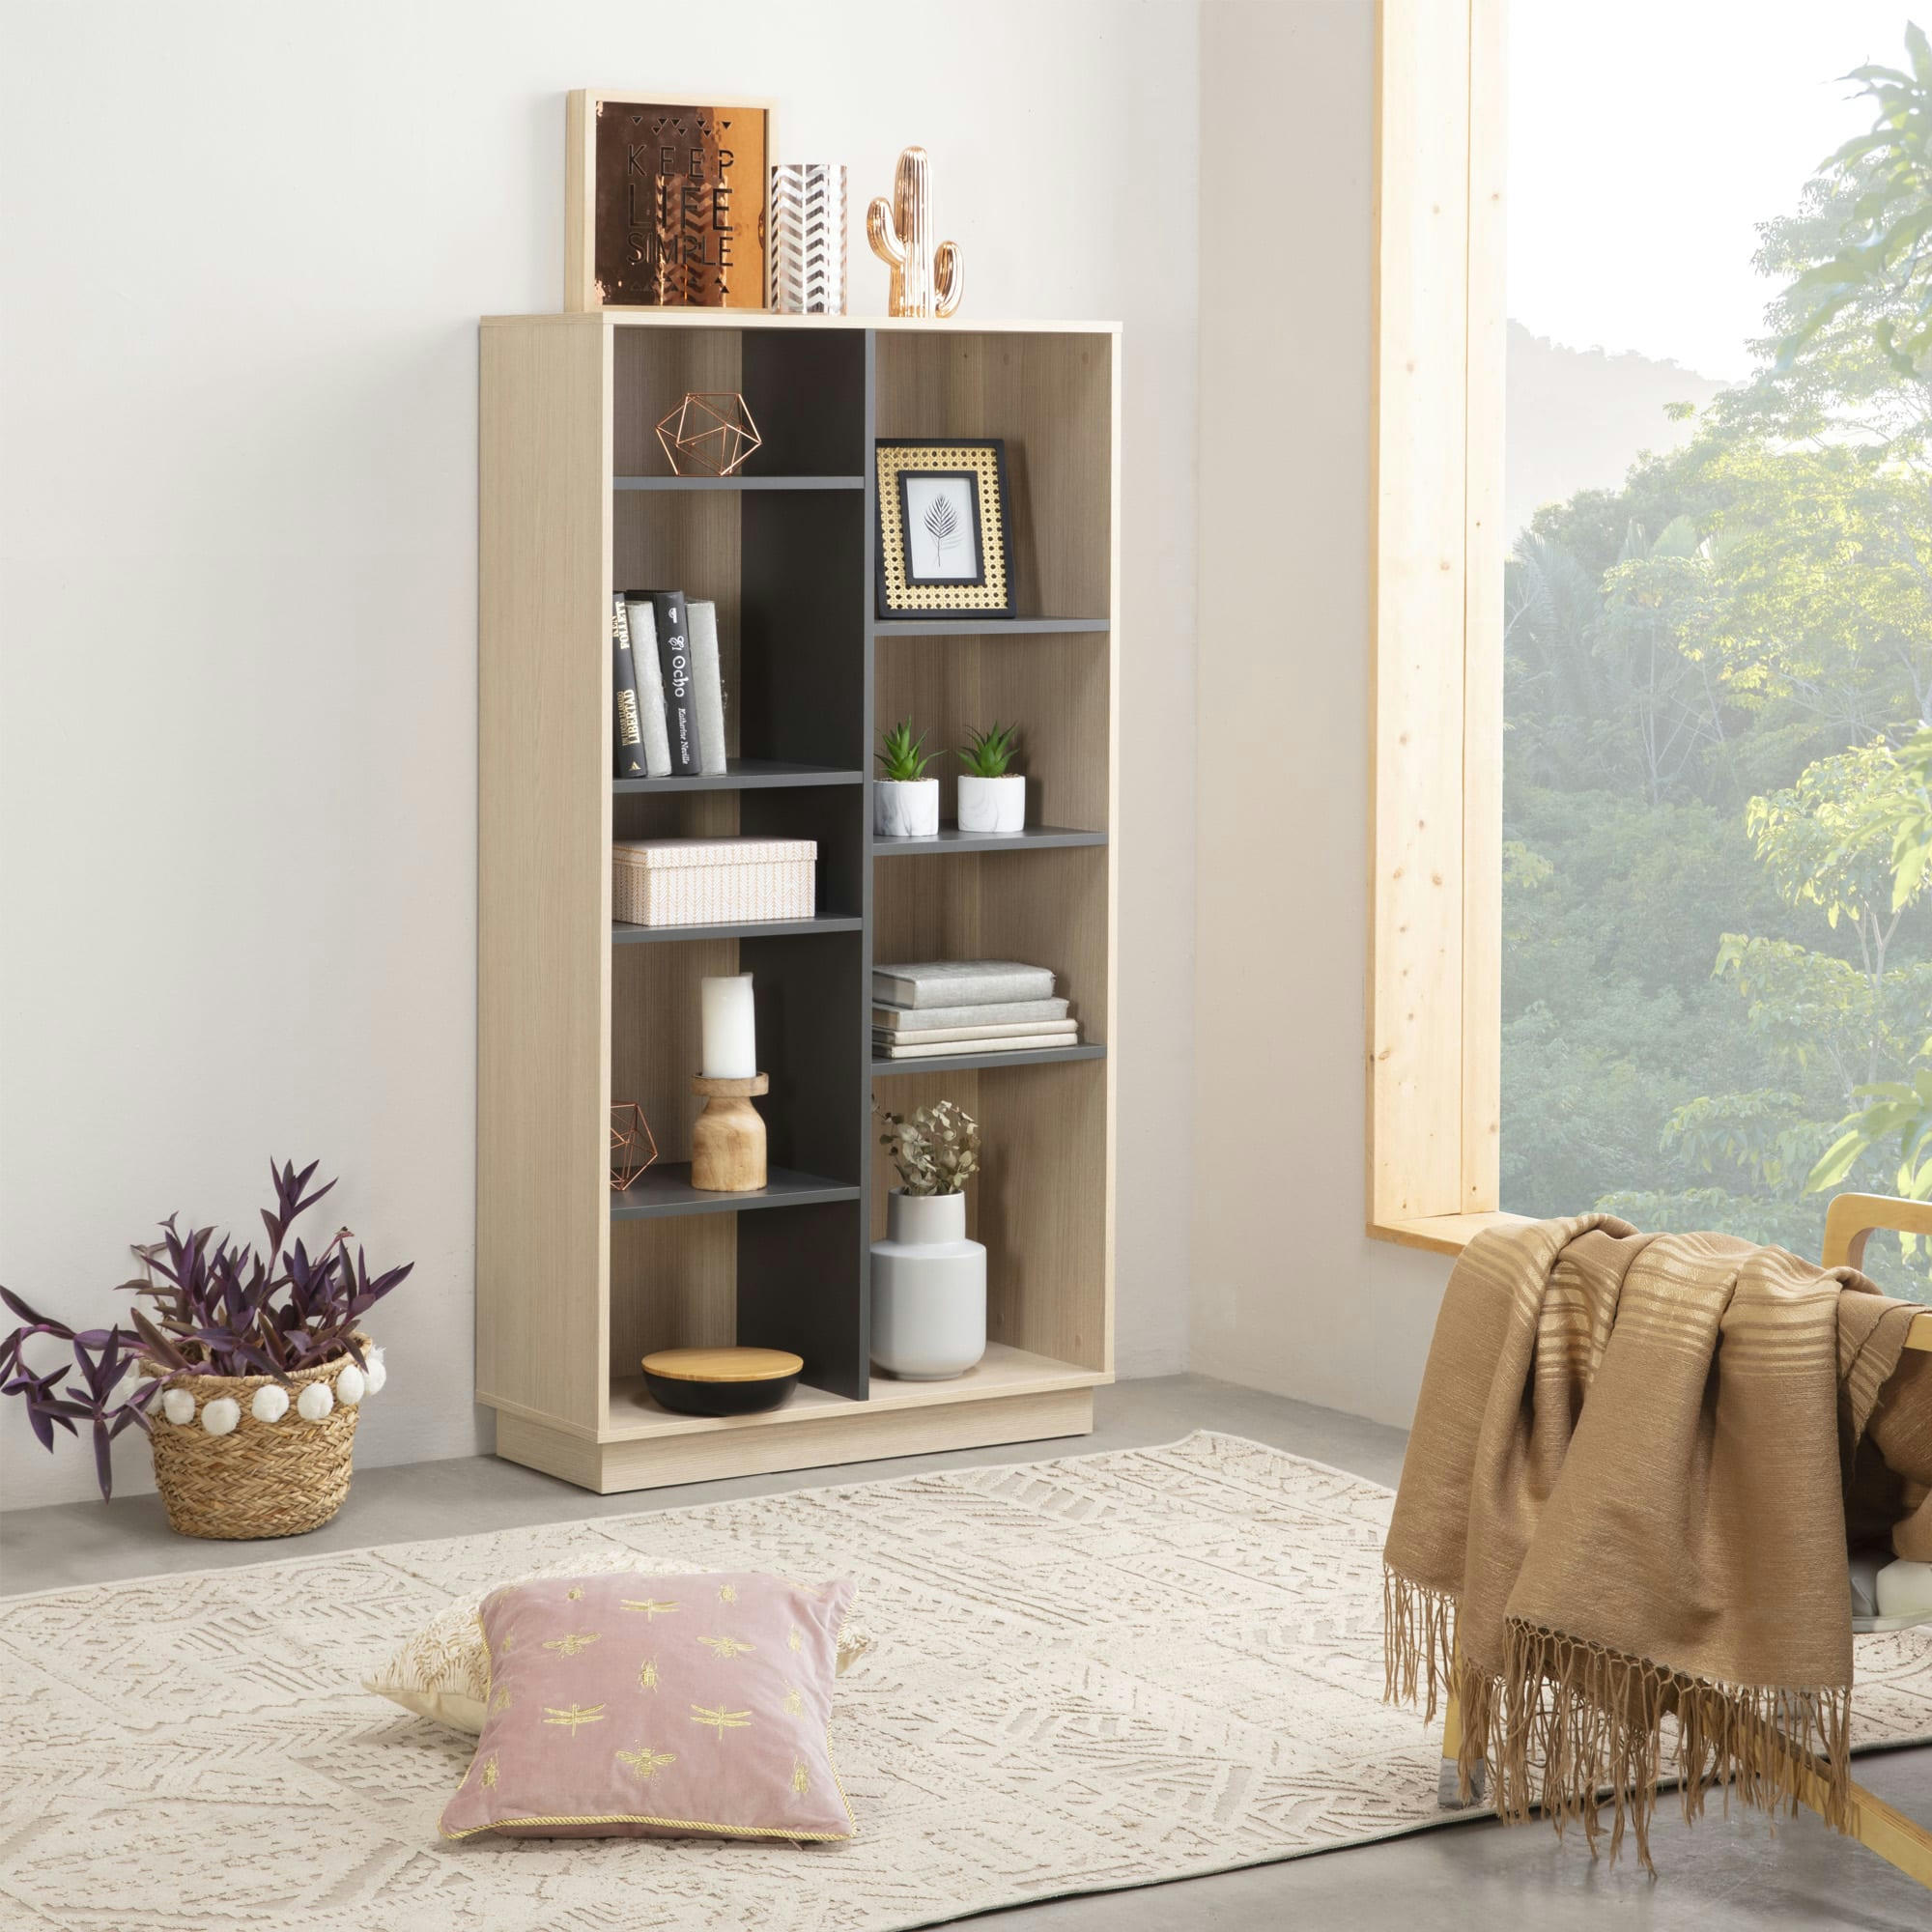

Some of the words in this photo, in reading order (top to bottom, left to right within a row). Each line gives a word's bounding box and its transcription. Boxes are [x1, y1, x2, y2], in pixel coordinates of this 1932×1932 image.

[628, 145, 734, 180] KEEP
[629, 184, 734, 232] LIFE
[627, 231, 734, 267] SIMPLE
[615, 601, 630, 649] FOLLETT
[672, 655, 689, 697] Ocho
[623, 689, 640, 744] LIBERTAD
